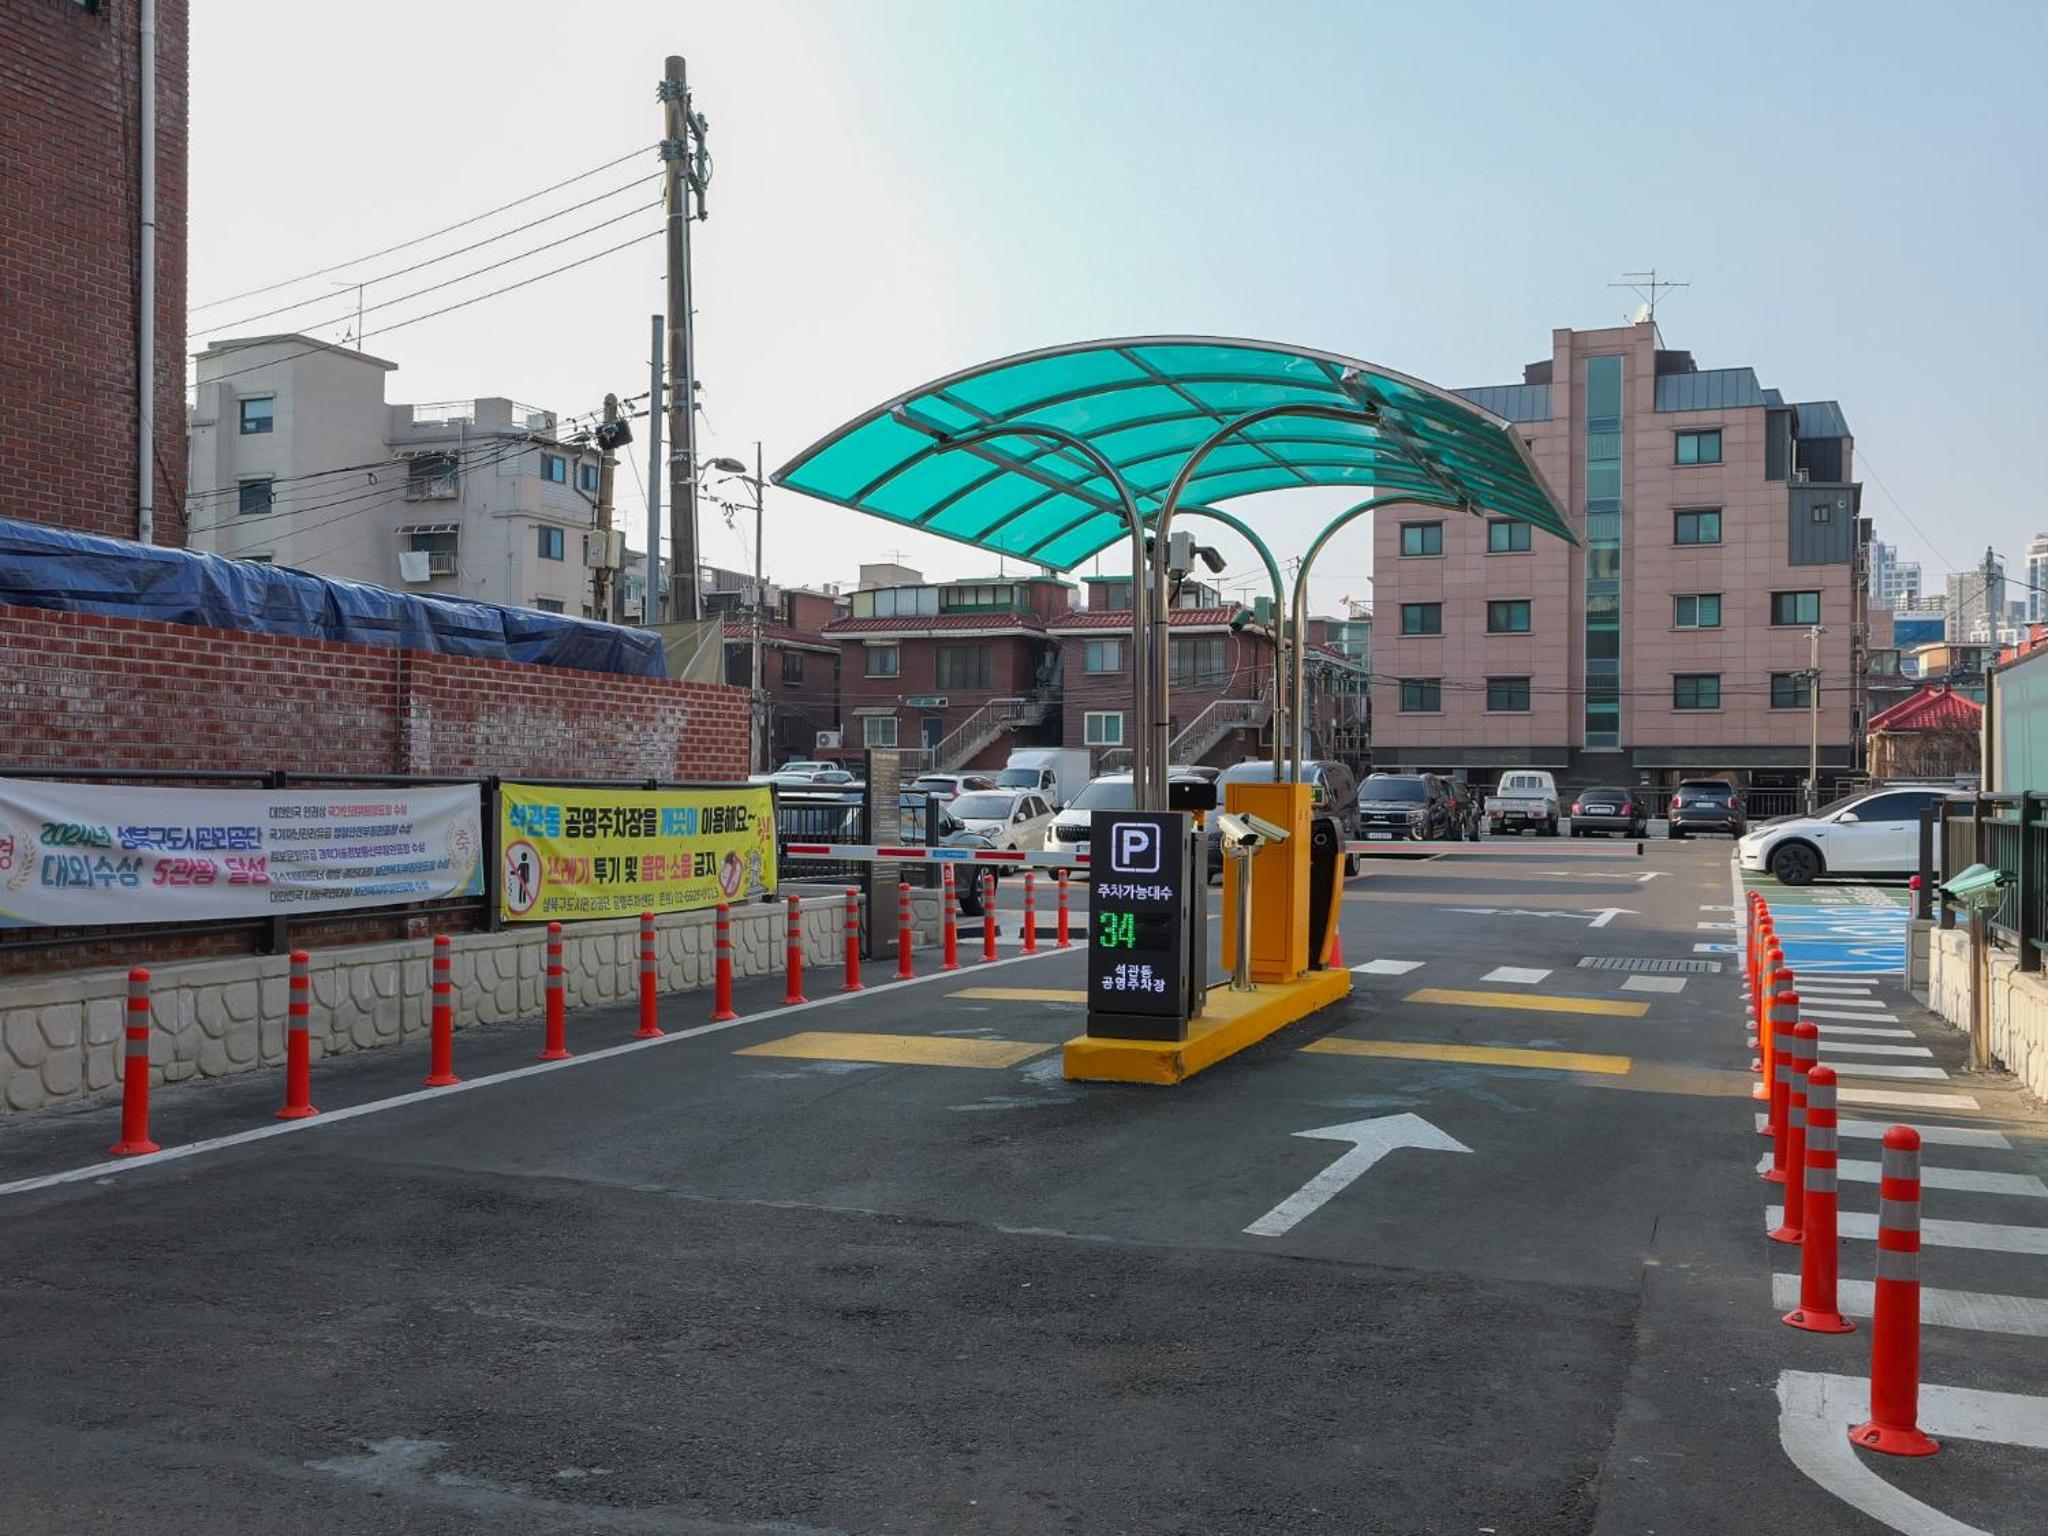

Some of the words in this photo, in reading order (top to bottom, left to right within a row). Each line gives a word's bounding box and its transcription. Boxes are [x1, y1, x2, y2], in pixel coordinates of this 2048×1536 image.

[41, 822, 112, 848] 2024년
[118, 826, 262, 850] 성북구도시관리공단
[510, 804, 560, 838] 석관동
[565, 805, 657, 838] 공영주차장을
[661, 807, 697, 836] 깨끗이
[1122, 830, 1149, 865] P
[42, 854, 144, 887] 대외수상
[153, 856, 218, 886] 5관왕
[225, 856, 270, 884] 달성
[547, 856, 591, 885] 쓰레기
[594, 856, 620, 884] 투기
[625, 856, 638, 882] 및
[695, 851, 716, 877] 금지
[1098, 883, 1173, 901] 주차가능대수
[1100, 912, 1136, 949] 34
[1102, 976, 1166, 992] 공영주차장
[1115, 964, 1153, 979] 석관동
